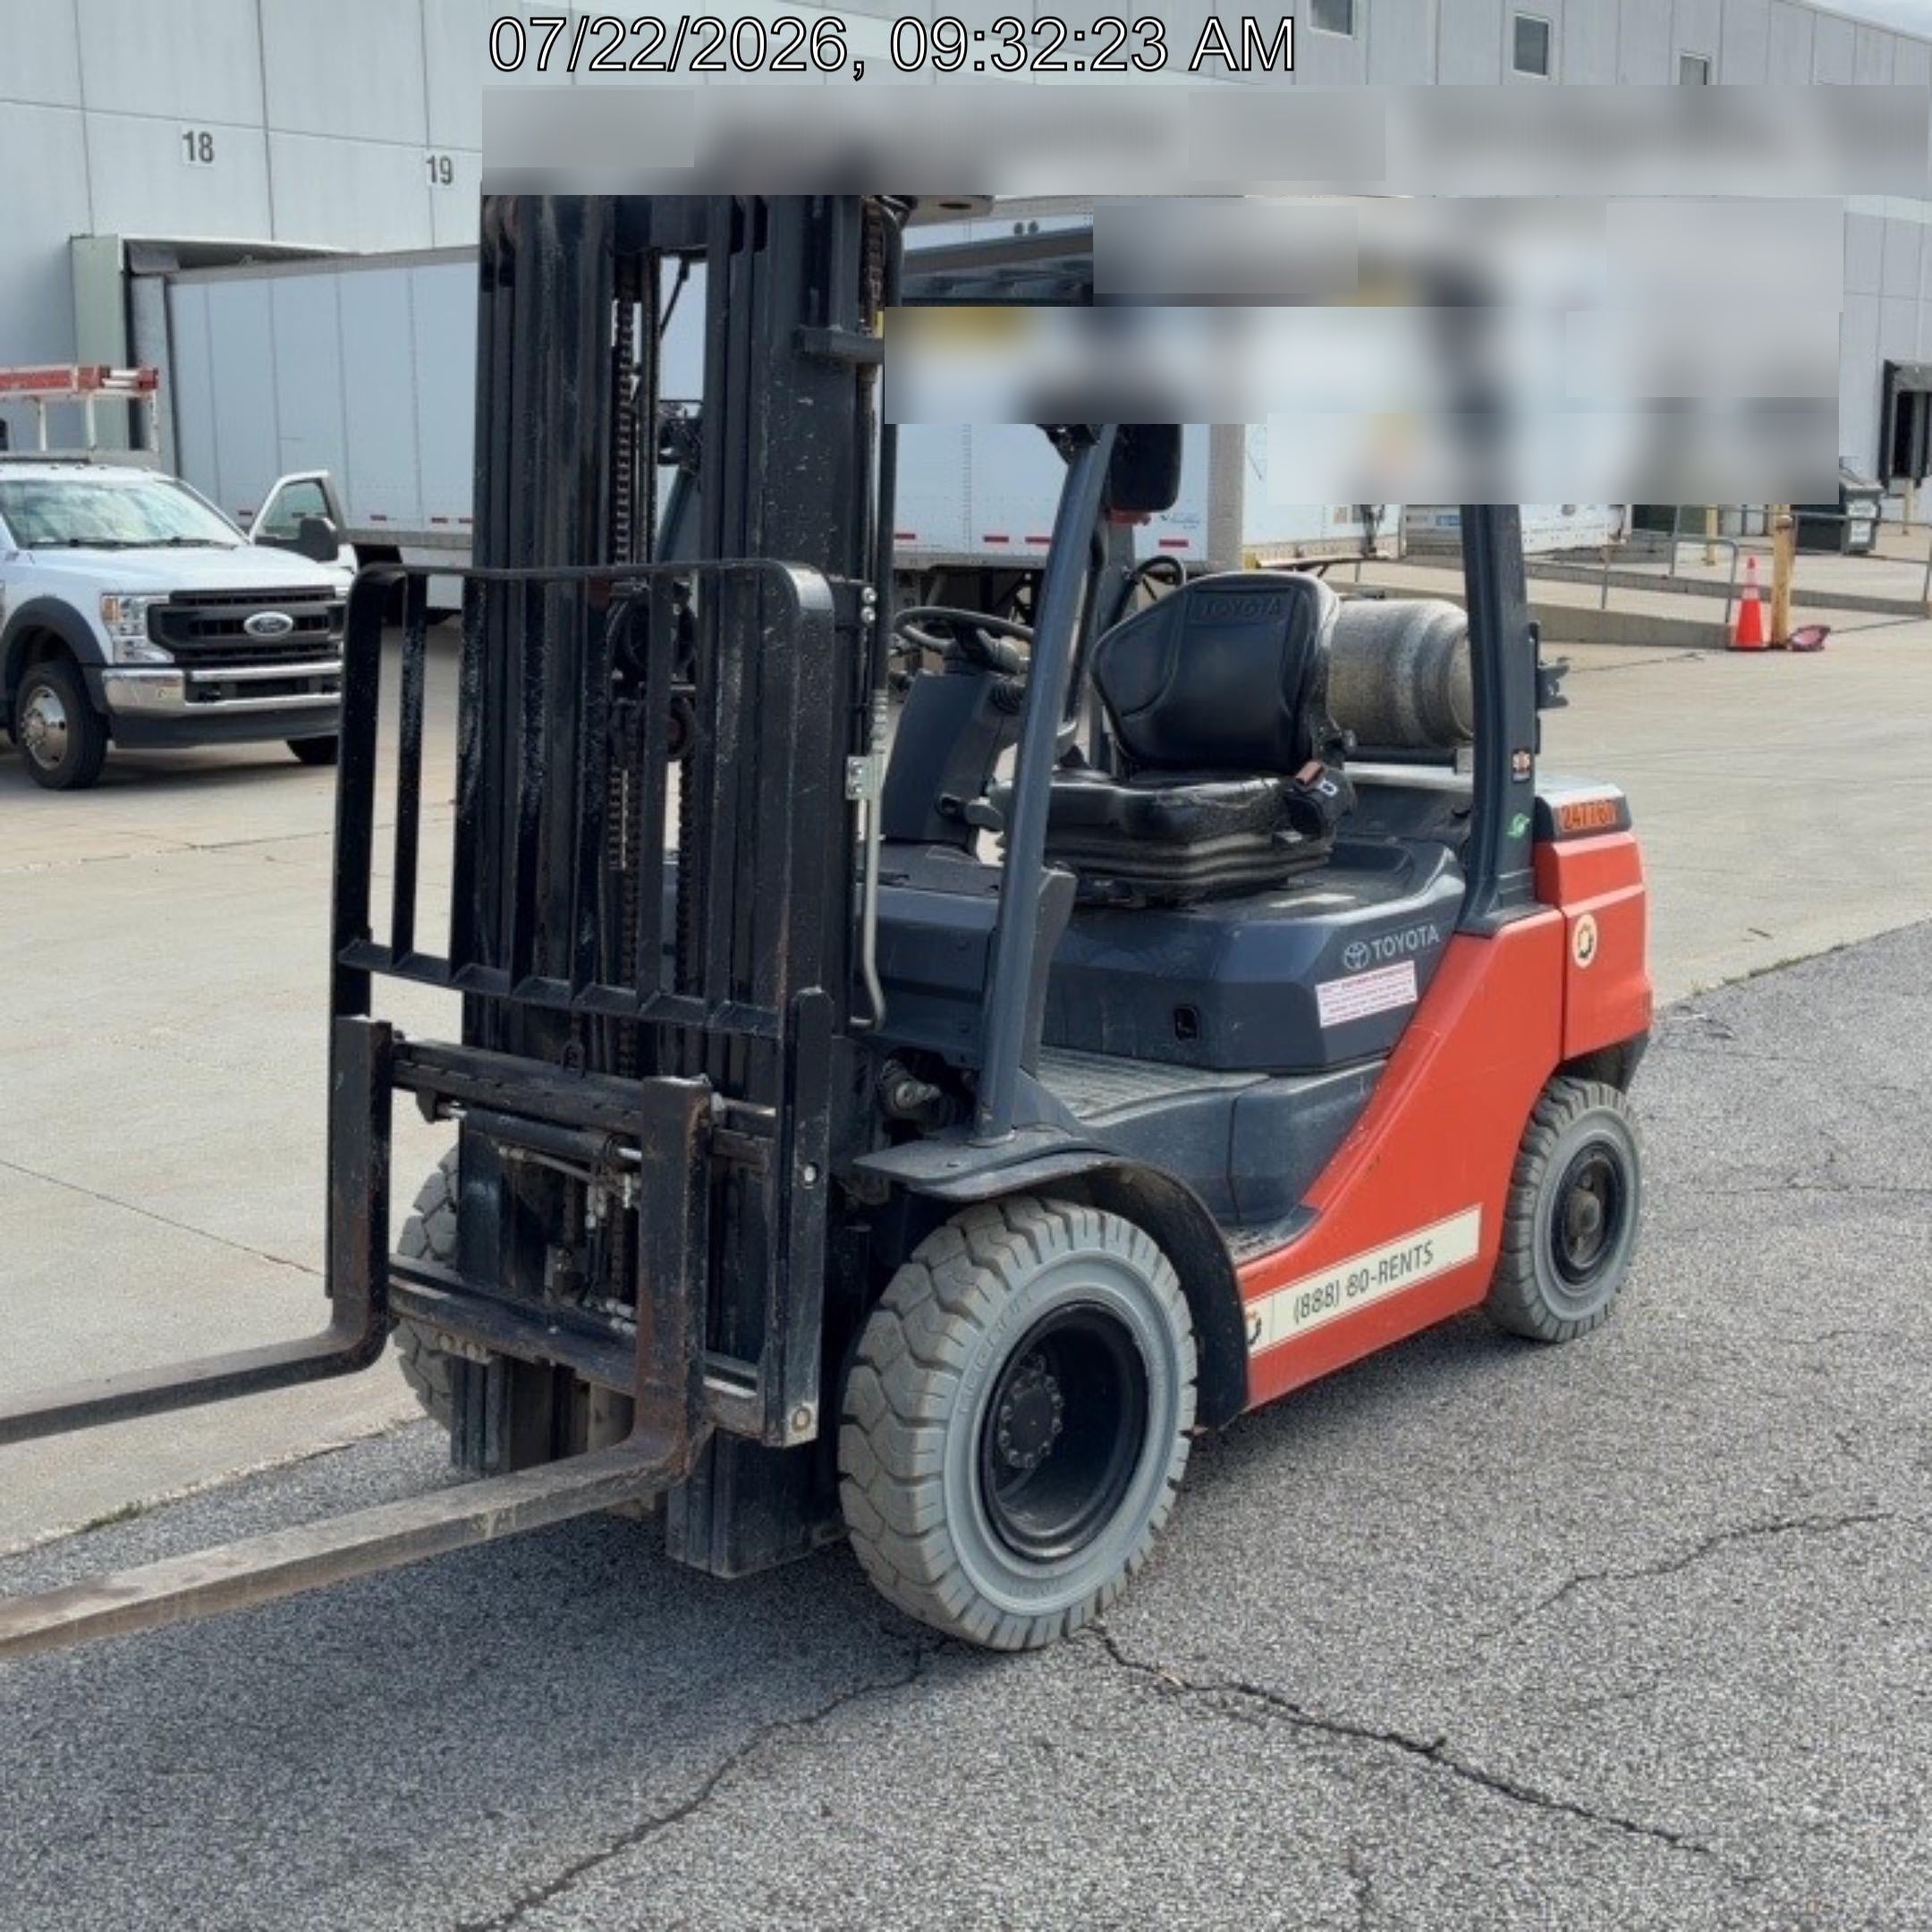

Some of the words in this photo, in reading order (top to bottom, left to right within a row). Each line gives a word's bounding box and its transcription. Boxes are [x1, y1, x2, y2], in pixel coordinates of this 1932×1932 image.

[182, 131, 215, 163] 18
[426, 155, 454, 185] 19
[1201, 595, 1282, 617] TOYOTA
[1371, 924, 1440, 960] TOYOTA
[1293, 1279, 1341, 1324] (888)
[1346, 1240, 1435, 1297] 80-RENTS
